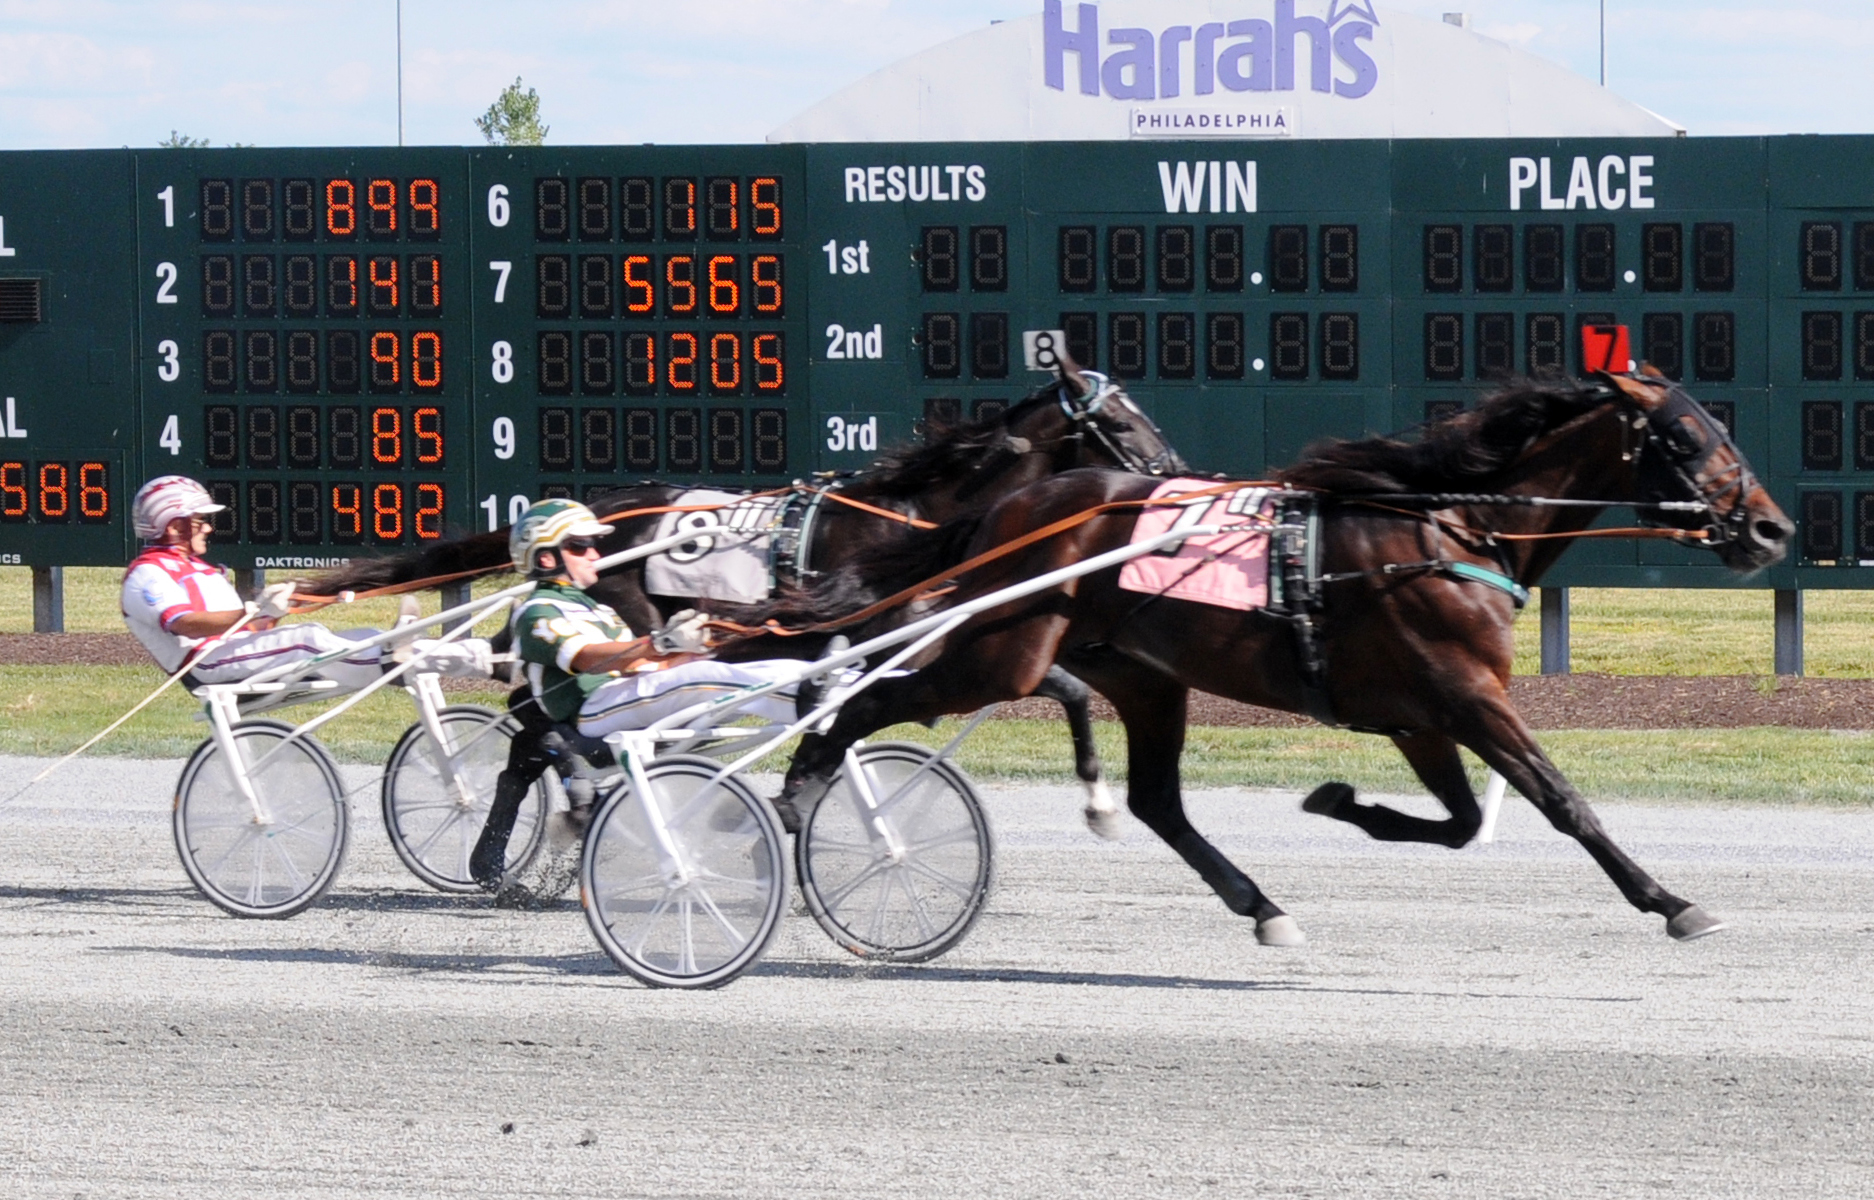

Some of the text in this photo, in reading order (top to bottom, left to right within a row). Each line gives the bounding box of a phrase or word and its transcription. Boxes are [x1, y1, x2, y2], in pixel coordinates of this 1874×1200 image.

[1138, 115, 1285, 127] PHILADELPHIA
[845, 165, 985, 202] RESULTS
[1158, 161, 1256, 212] WIN
[1510, 155, 1654, 210] PLACE
[158, 180, 437, 233] 1 899
[489, 179, 779, 233] 6 115
[823, 240, 869, 274] 1st
[157, 261, 439, 306] 2 141
[490, 256, 781, 311] 7 5565
[159, 333, 440, 386] 3 90
[493, 333, 782, 388] 8 1205
[827, 324, 882, 358] 2nd
[1035, 332, 1055, 369] 8
[1595, 327, 1618, 372] 7
[0, 398, 27, 437] L
[160, 408, 442, 462] 4 85
[493, 417, 514, 459] 9
[828, 417, 876, 451] 3rd
[334, 484, 443, 538] 482
[480, 494, 530, 532] 10
[1160, 491, 1217, 554] 7
[669, 510, 721, 565] 8
[255, 557, 350, 568] DAKTRONICS
